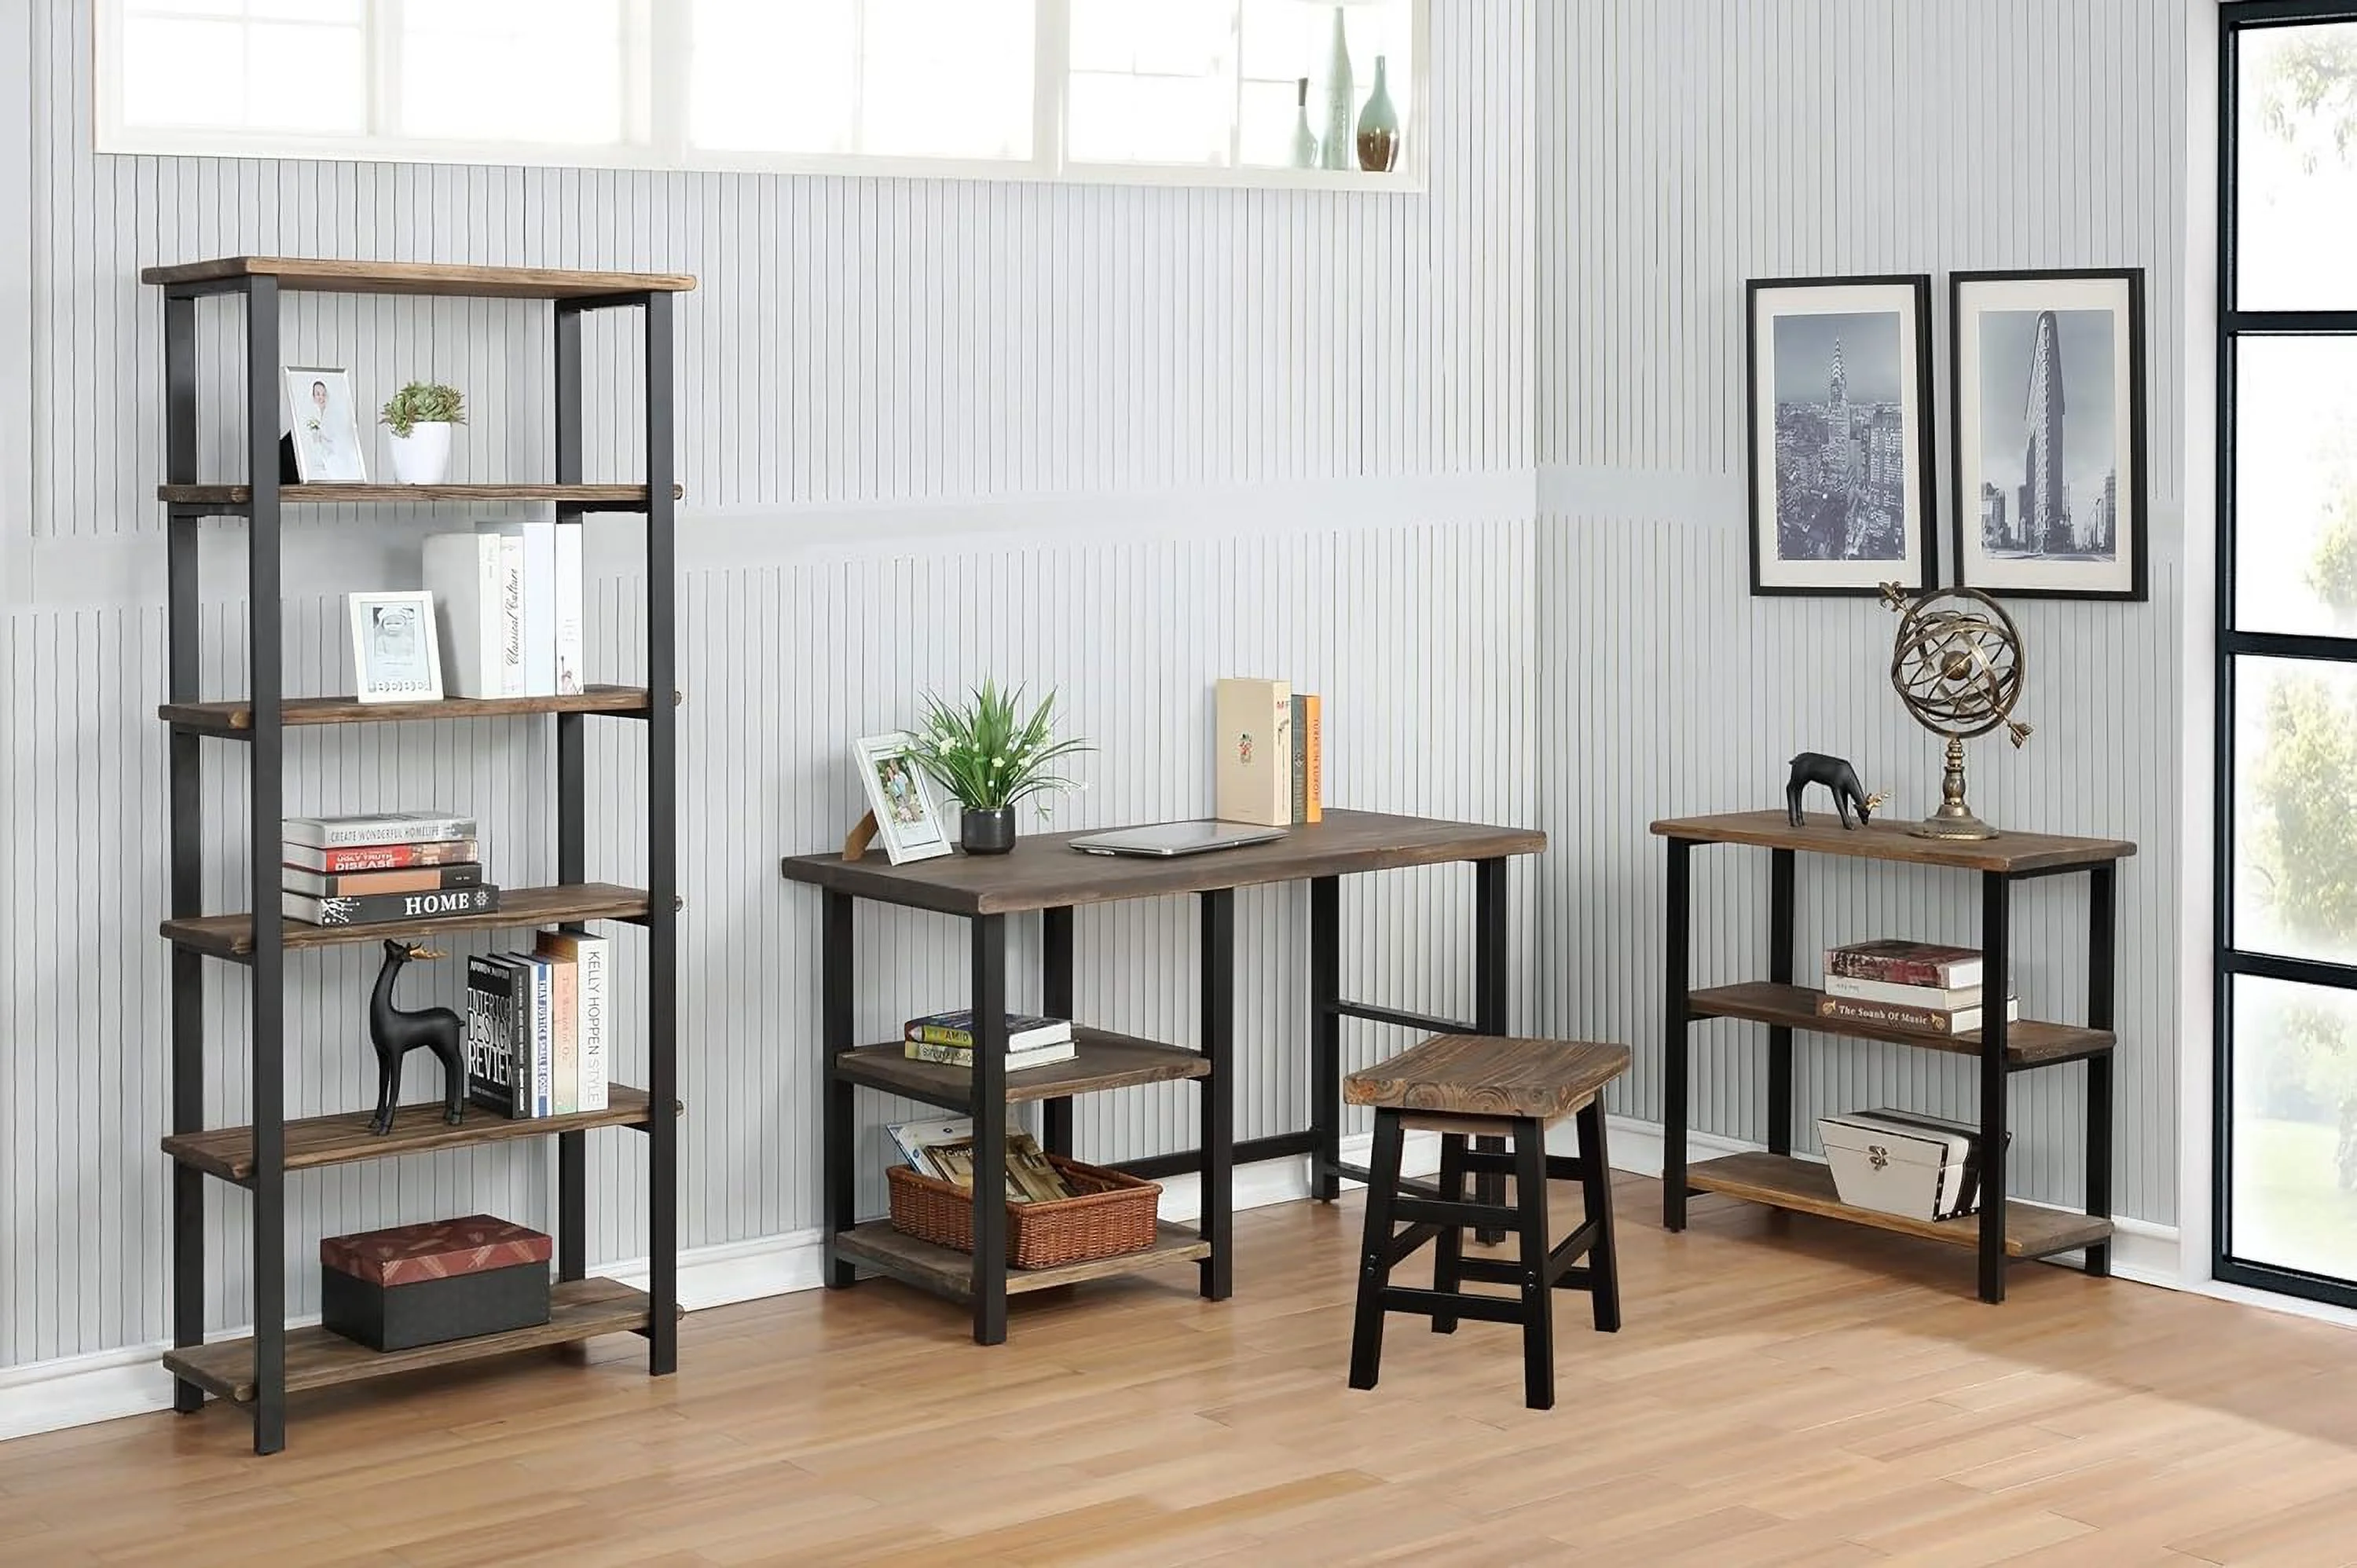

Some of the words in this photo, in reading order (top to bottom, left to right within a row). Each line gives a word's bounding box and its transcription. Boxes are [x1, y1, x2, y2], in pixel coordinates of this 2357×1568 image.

[405, 893, 470, 916] HOME
[587, 951, 600, 993] KELLY
[468, 1009, 512, 1055] DESIGN
[587, 998, 600, 1056] HOPPEN
[1838, 1006, 1856, 1015] The
[1888, 1011, 1900, 1020] Of
[1901, 1013, 1927, 1024] Music
[588, 1061, 600, 1104] STYLE
